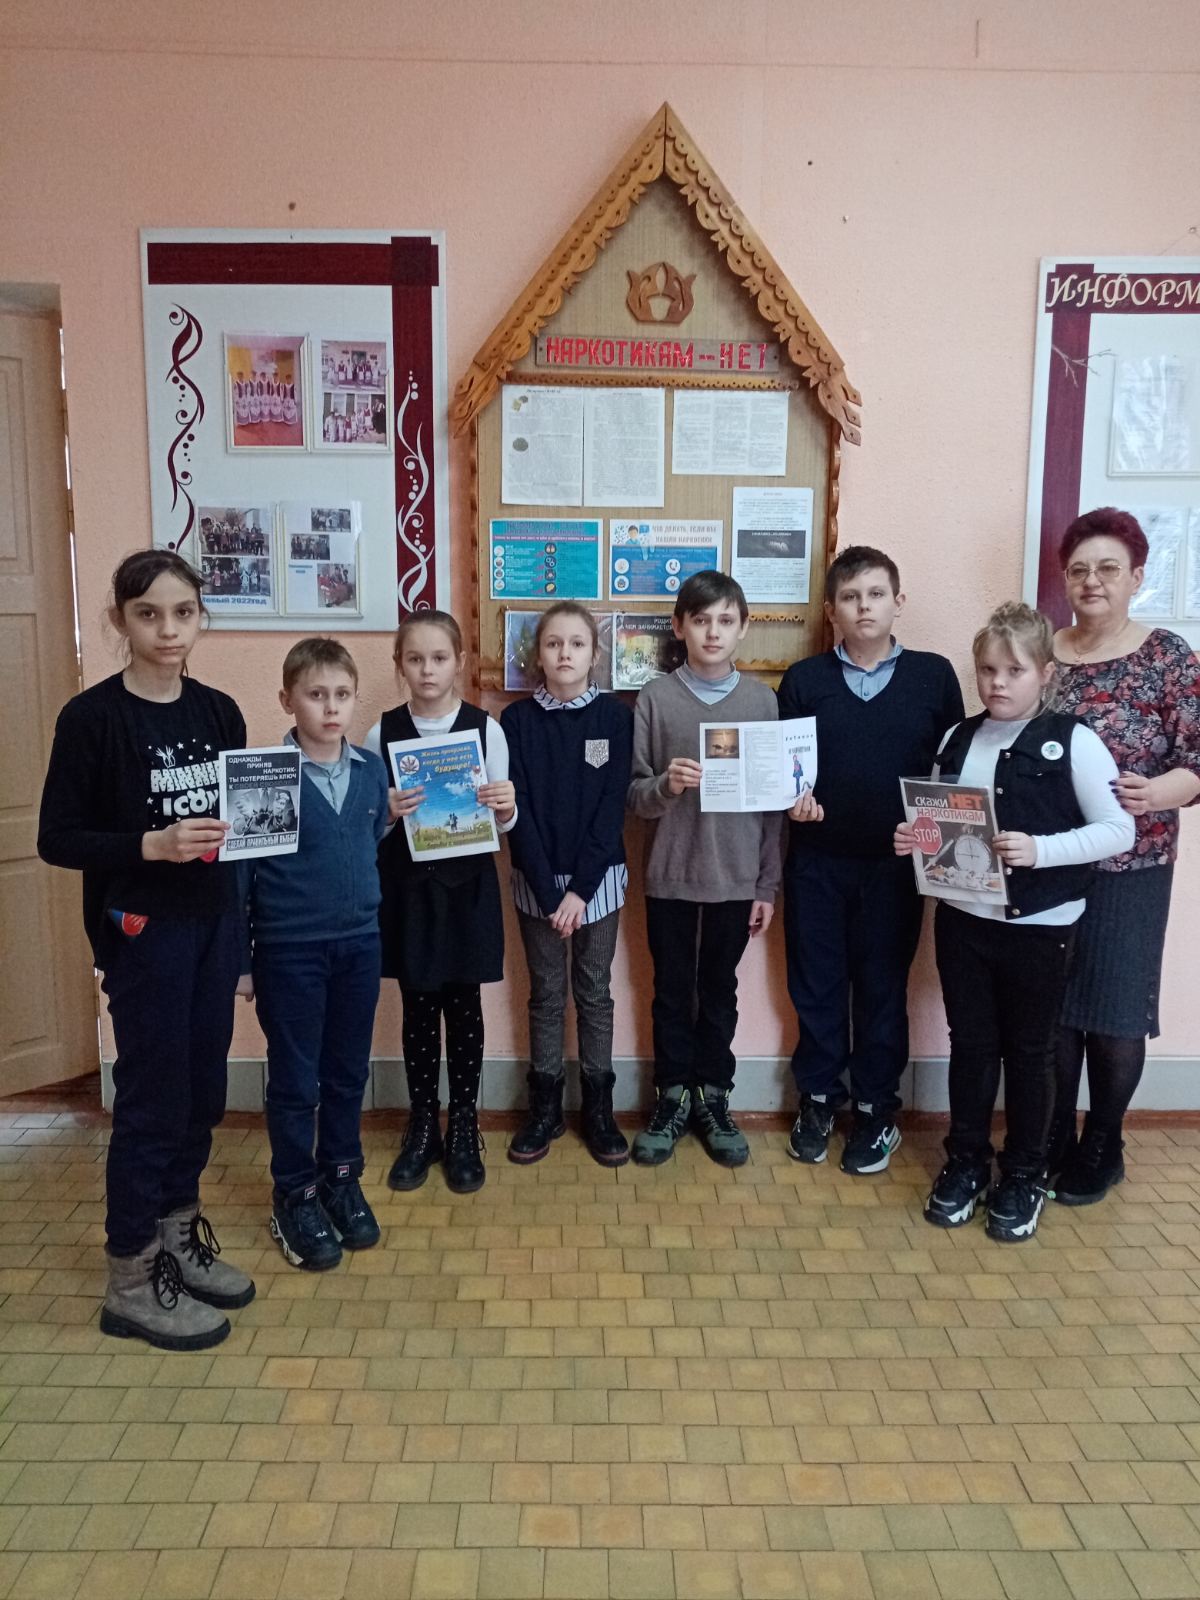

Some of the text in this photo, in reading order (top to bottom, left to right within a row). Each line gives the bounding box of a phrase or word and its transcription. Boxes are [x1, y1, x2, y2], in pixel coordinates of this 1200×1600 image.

[546, 336, 694, 368] НАРКОТИКАМ
[719, 342, 768, 370] НЕТ
[228, 756, 262, 764] ОДНАЖДЫ
[246, 761, 273, 769] ПРИНЯВ
[240, 774, 278, 782] ПОТЕРЯЕШЬ
[947, 792, 984, 810] НЕТ
[914, 828, 939, 842] STOP
